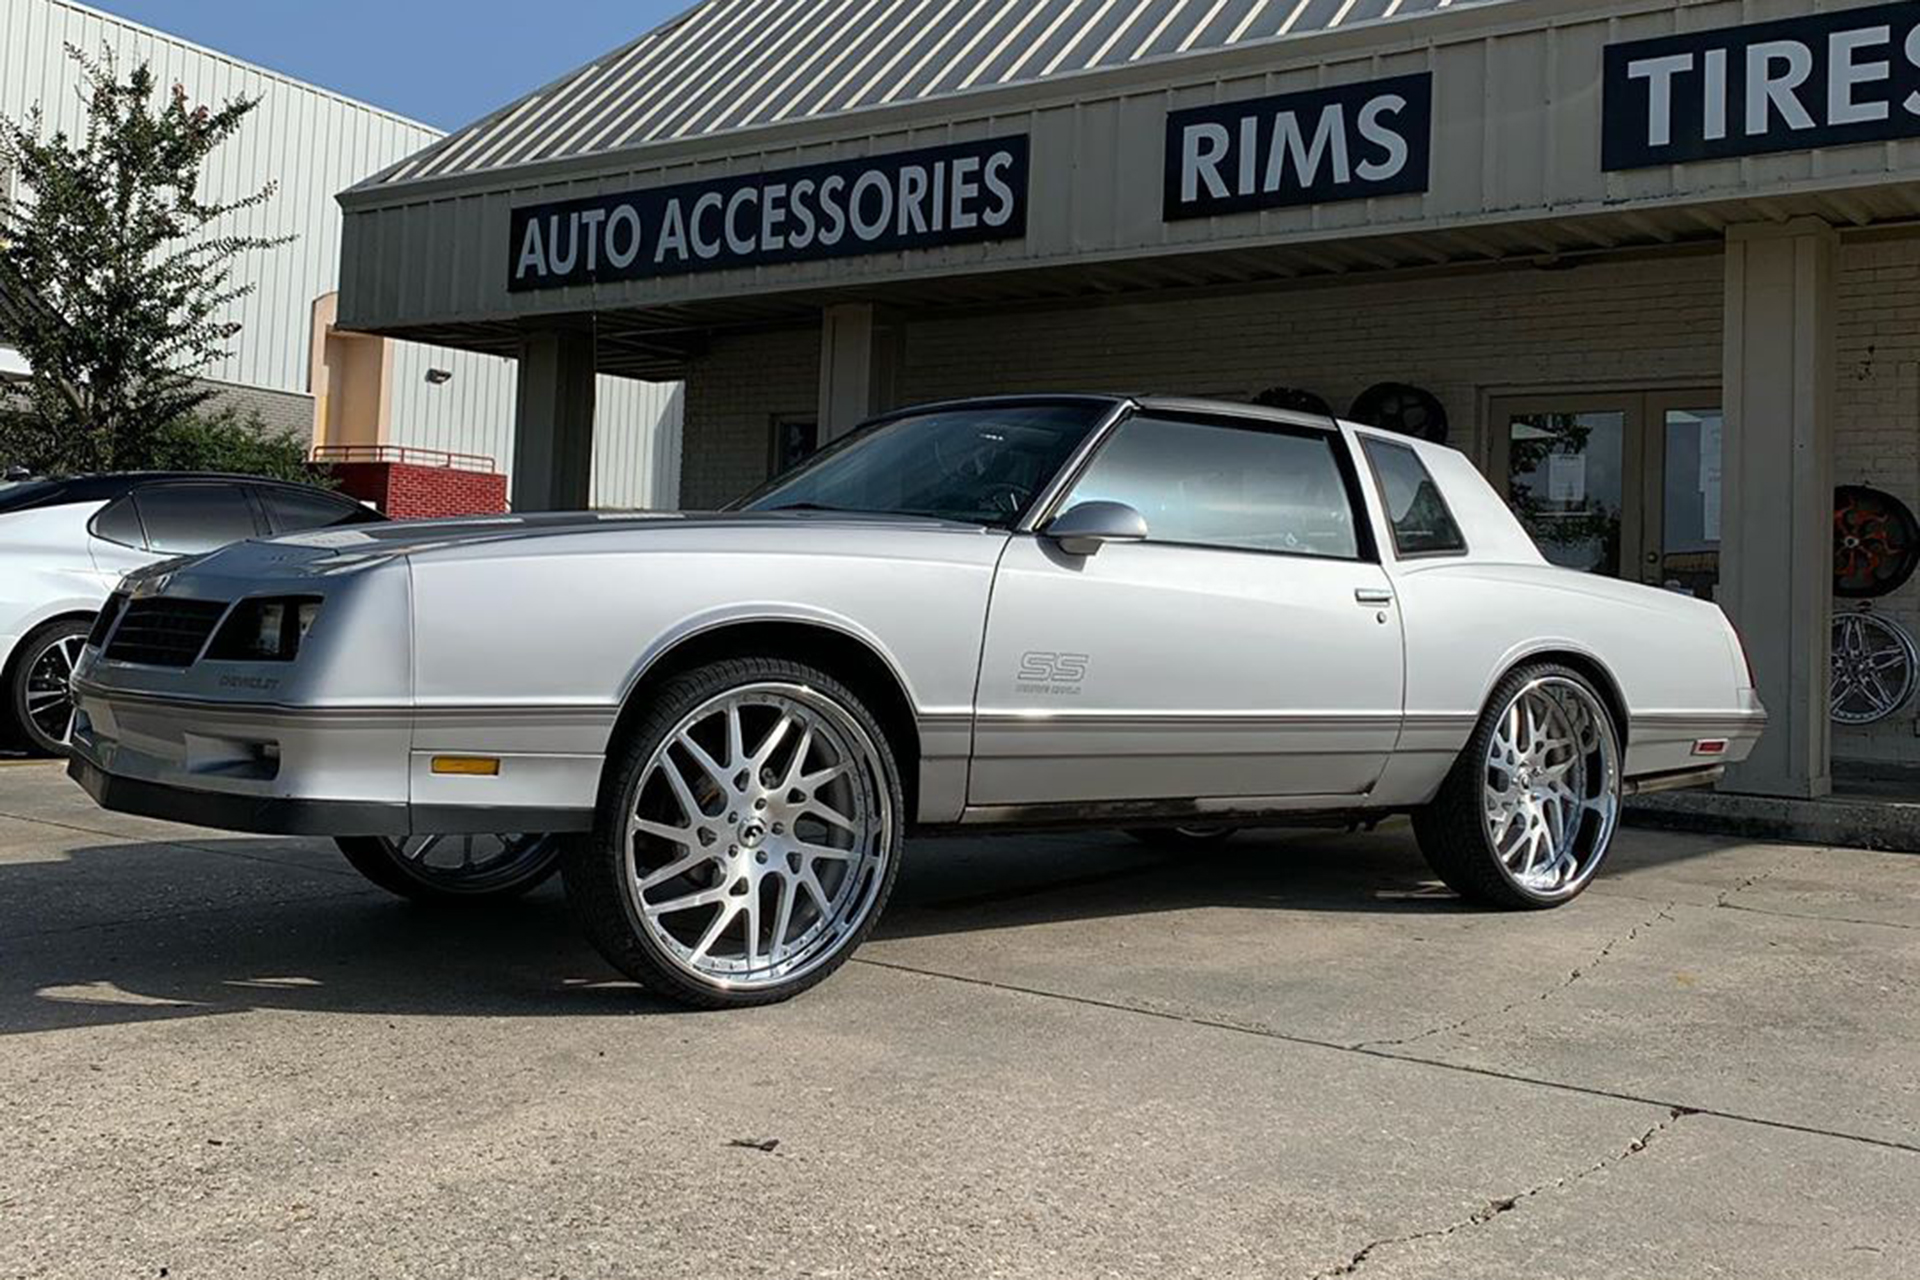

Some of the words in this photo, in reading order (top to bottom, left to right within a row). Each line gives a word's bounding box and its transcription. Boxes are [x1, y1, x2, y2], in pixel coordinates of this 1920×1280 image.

[1627, 22, 1920, 148] TIRE
[1180, 94, 1408, 204] RIMS
[515, 203, 641, 280] AUTO
[653, 150, 1014, 264] ACCESSORIES
[1017, 651, 1090, 682] SS
